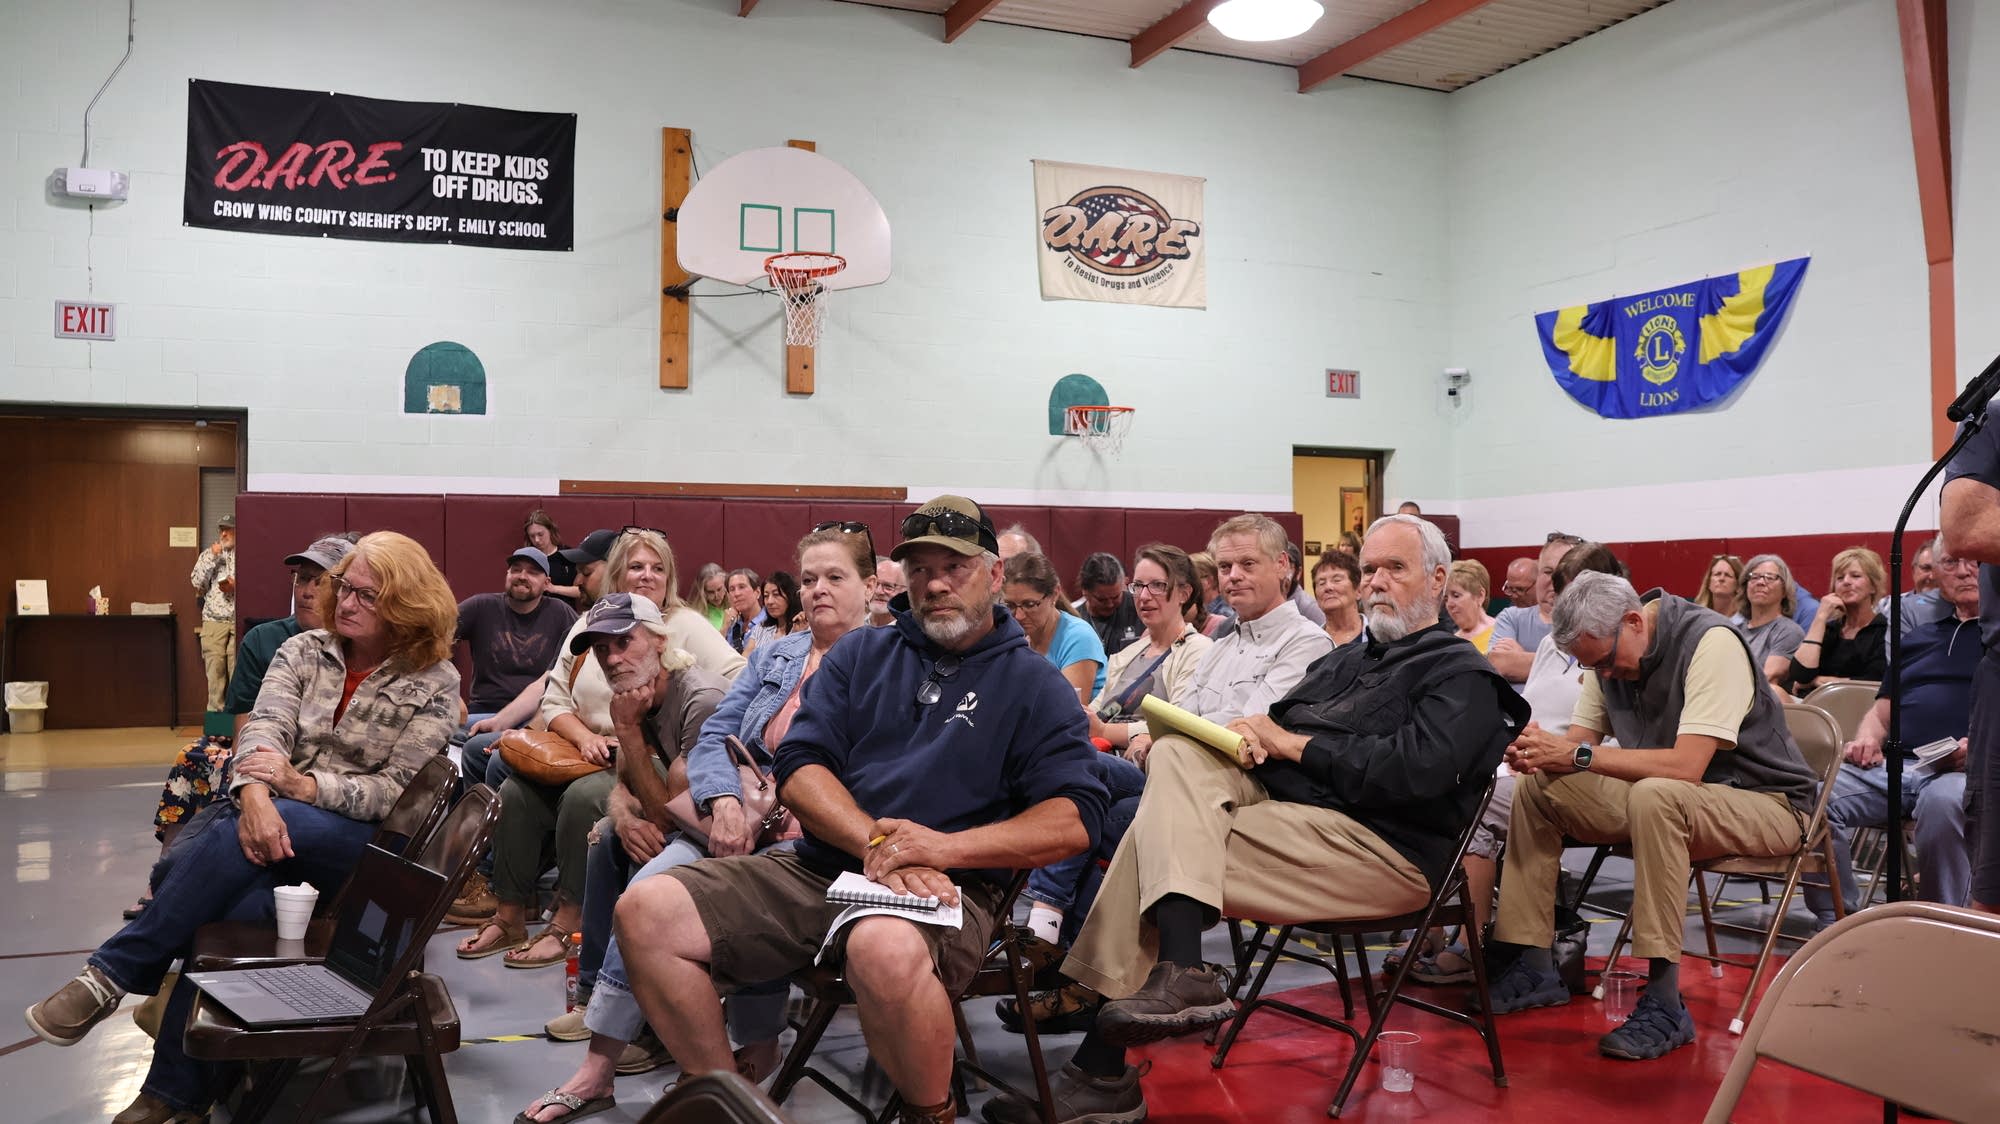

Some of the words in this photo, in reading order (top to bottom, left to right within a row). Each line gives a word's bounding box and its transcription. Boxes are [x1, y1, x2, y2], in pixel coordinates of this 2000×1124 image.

[214, 140, 403, 191] D.A.R.E.
[421, 148, 447, 172] TO
[452, 150, 500, 176] KEEP
[504, 155, 549, 180] KIDS
[432, 175, 468, 199] OFF
[472, 178, 543, 205] DRUGS.
[213, 200, 255, 219] CROW
[258, 203, 292, 222] WING
[295, 207, 346, 226] COUNTY
[349, 211, 414, 230] SHERIFF'S
[416, 215, 452, 232] DEPT.
[458, 218, 496, 235] EMILY
[499, 221, 547, 238] SCHOOL
[1063, 255, 1074, 269] To
[1073, 264, 1099, 284] Resist
[1100, 277, 1126, 290] Drugs
[1128, 280, 1142, 289] and
[1142, 262, 1174, 286] Violence
[63, 305, 109, 334] EXIT
[1624, 293, 1695, 318] WELCOME
[1645, 317, 1675, 334] LIONS
[1654, 336, 1670, 361] L
[1330, 372, 1356, 393] EXIT
[1640, 388, 1679, 406] LIONS
